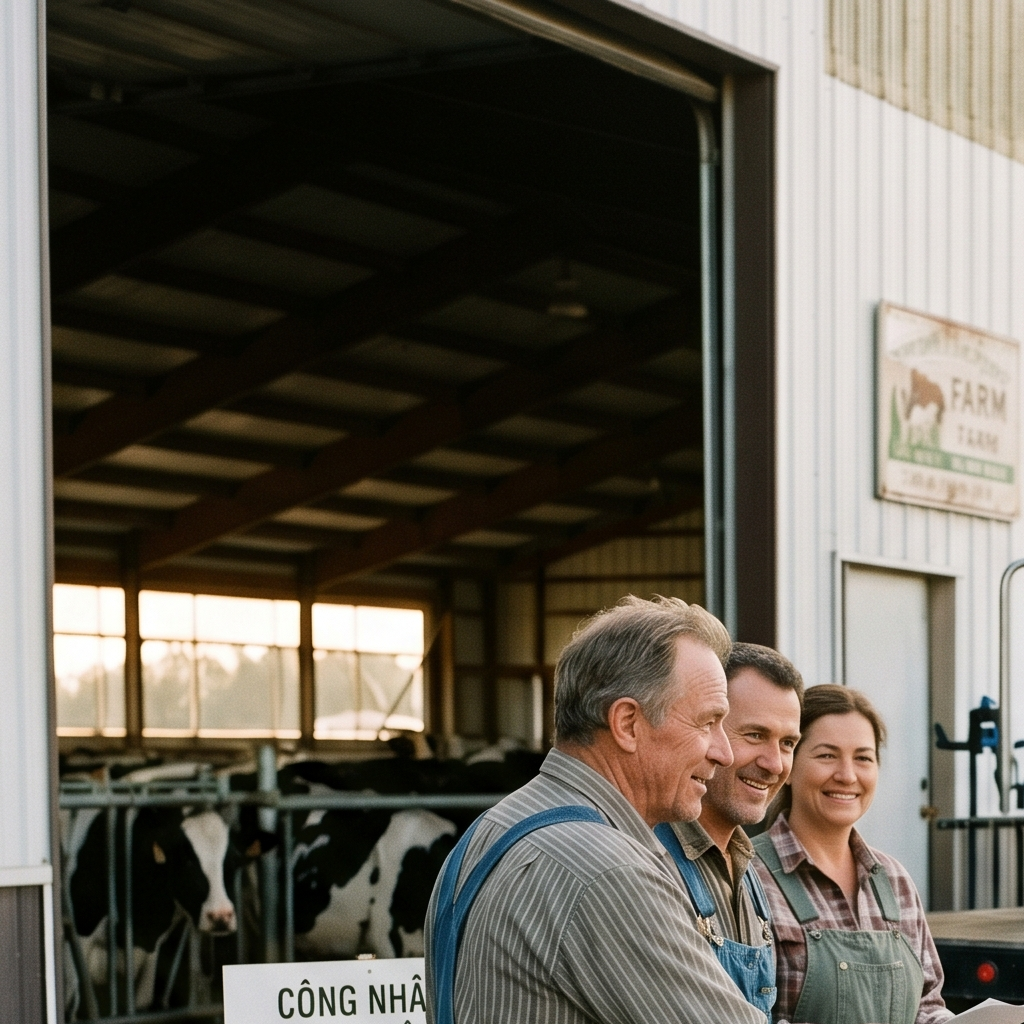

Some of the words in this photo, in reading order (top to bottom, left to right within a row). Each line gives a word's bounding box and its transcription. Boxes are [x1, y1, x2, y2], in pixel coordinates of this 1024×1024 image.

[951, 377, 1007, 423] FARM
[278, 979, 357, 1019] CÔNG
[369, 974, 427, 1014] NHÂ
